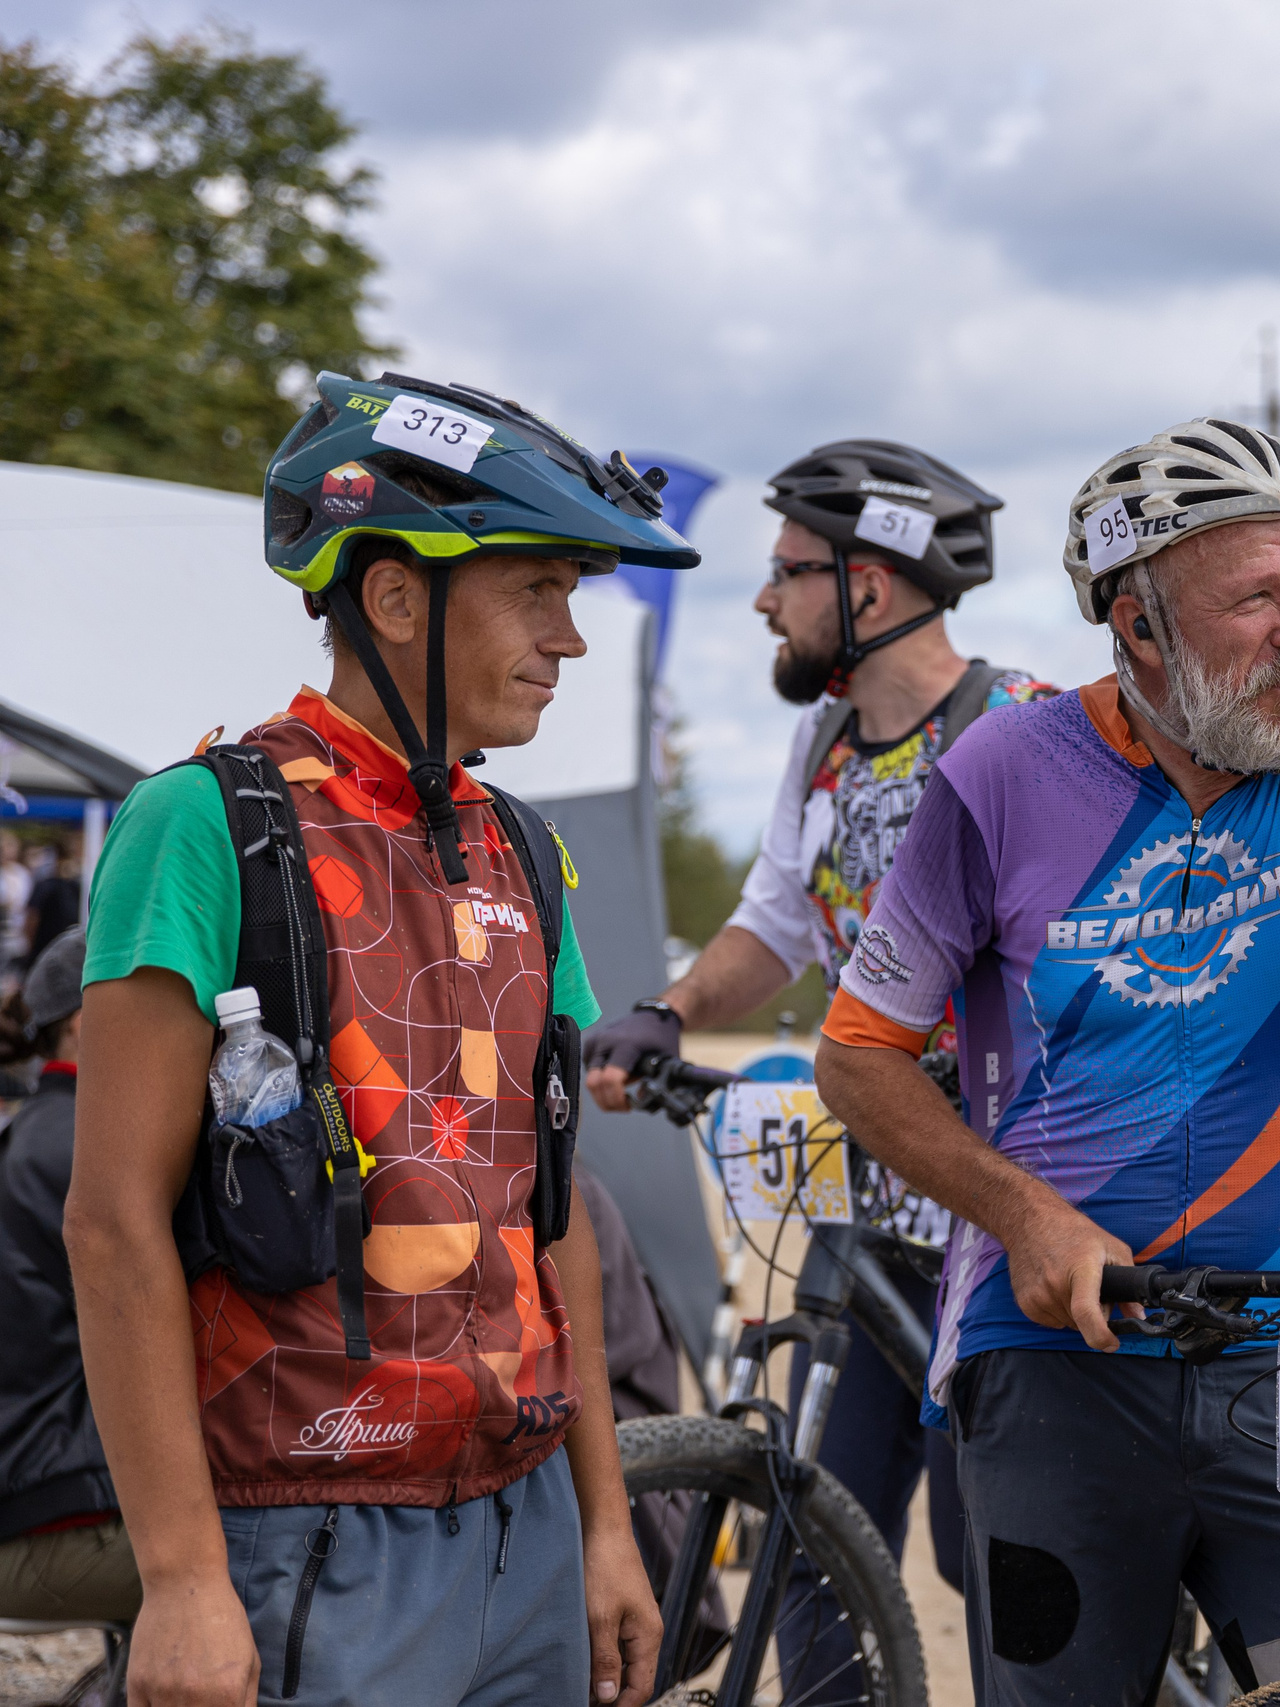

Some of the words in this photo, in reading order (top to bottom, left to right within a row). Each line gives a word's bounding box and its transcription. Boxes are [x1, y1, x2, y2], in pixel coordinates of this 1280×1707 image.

[403, 408, 468, 445] 313
[880, 510, 911, 538] 51
[1100, 508, 1128, 547] 95
[323, 1083, 352, 1153] OUTDOORS
[761, 1119, 806, 1188] 51
[289, 1383, 419, 1462] Прима
